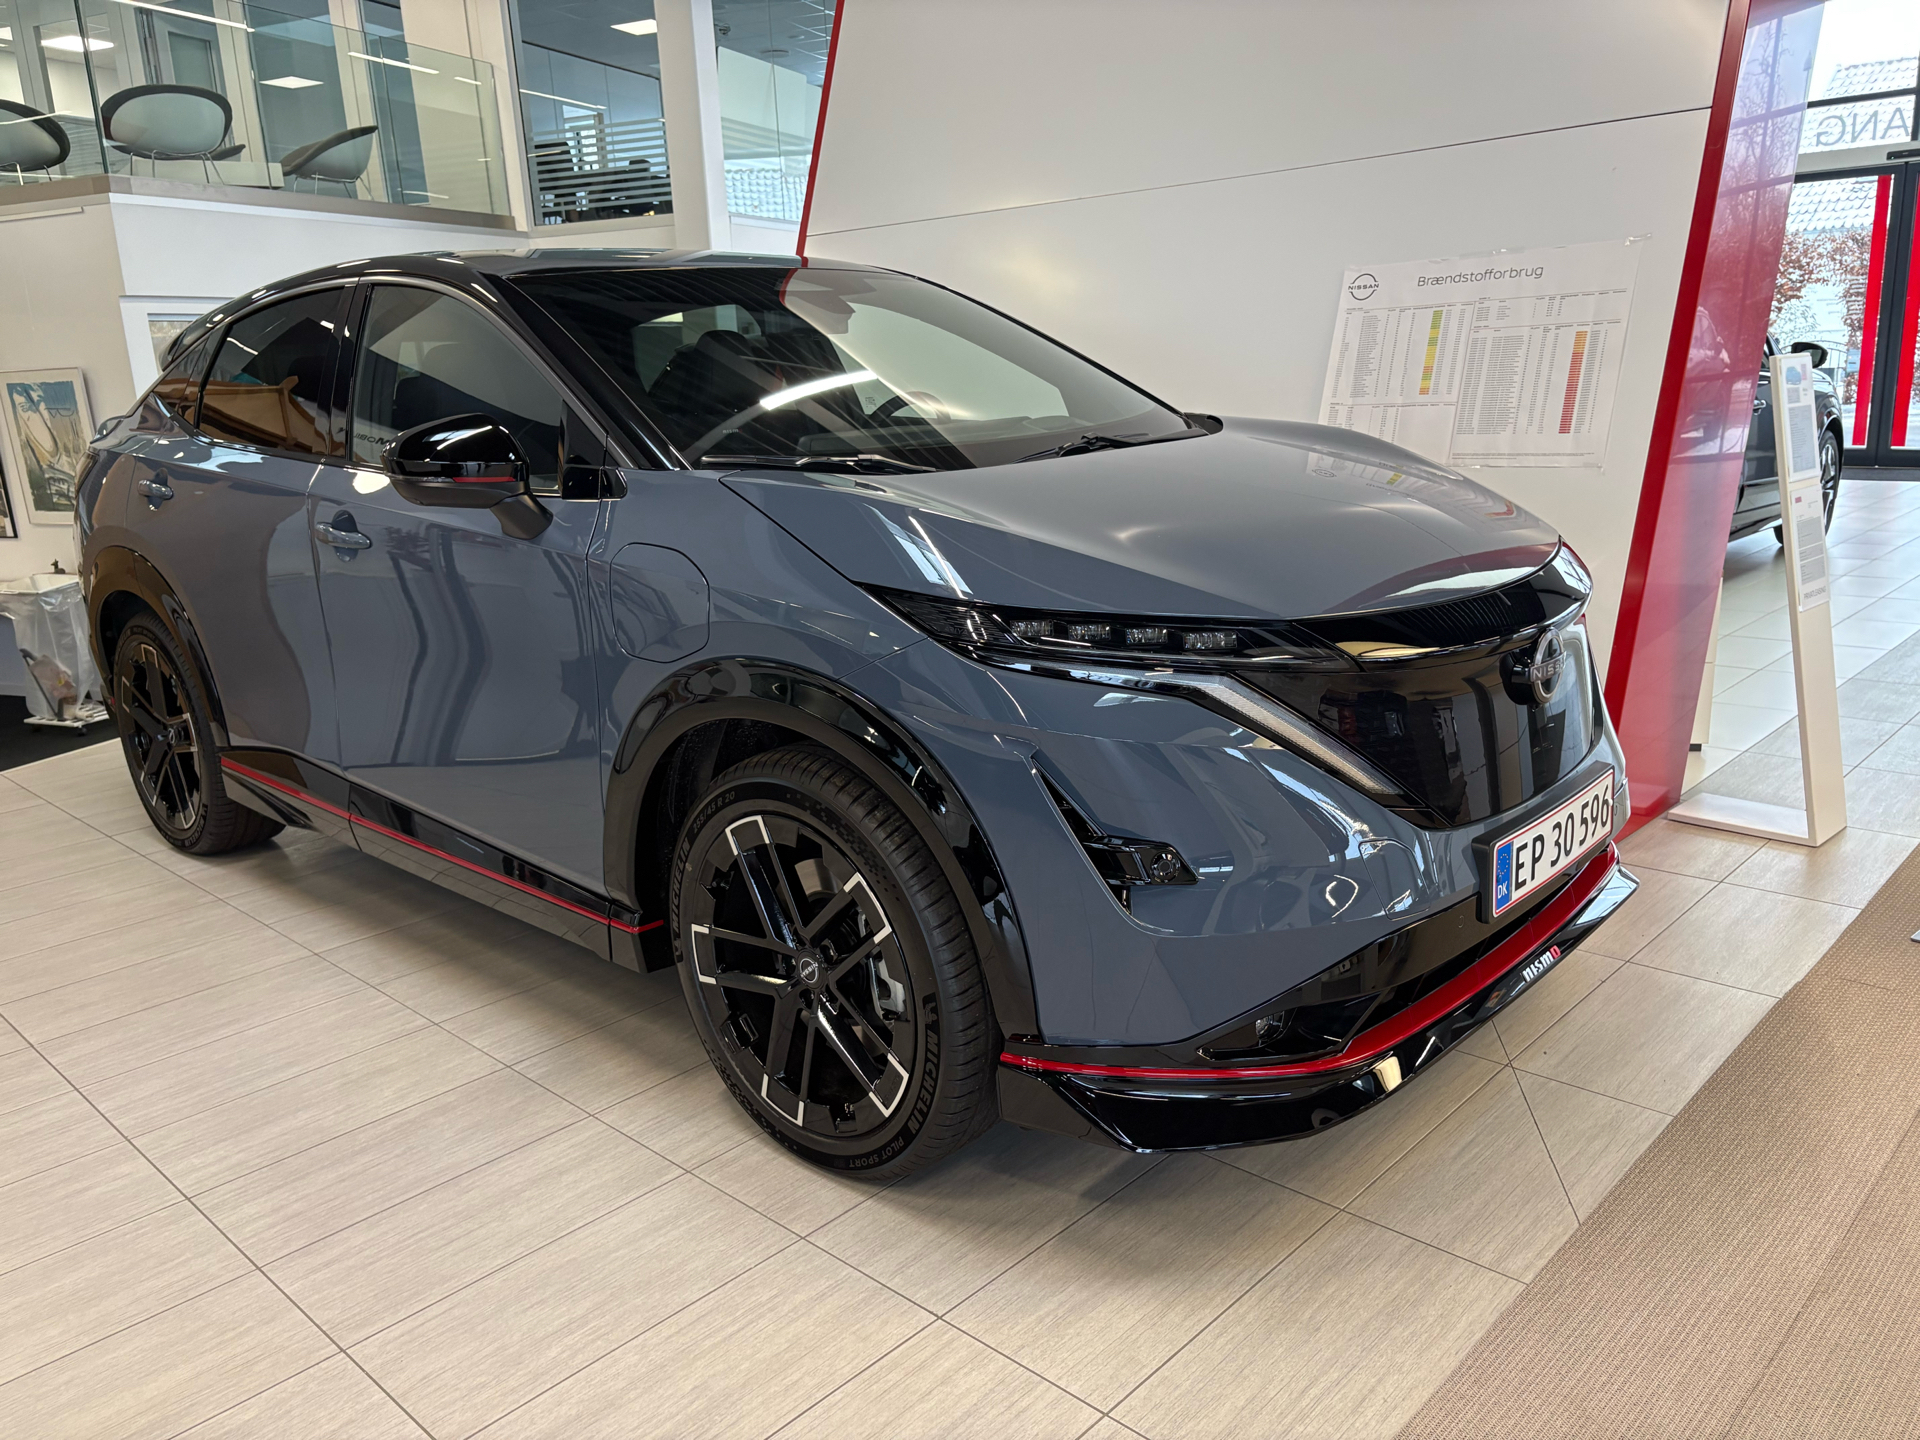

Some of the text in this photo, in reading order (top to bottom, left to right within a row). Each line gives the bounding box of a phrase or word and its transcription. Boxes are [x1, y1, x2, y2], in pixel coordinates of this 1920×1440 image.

[1348, 282, 1380, 291] NISSAN
[1417, 265, 1544, 287] Brændstofforbrug
[717, 796, 724, 807] R
[725, 790, 736, 803] 20
[1514, 784, 1610, 892] EP 30 596
[671, 837, 691, 935] MICHELIN
[1497, 880, 1508, 900] DK
[907, 1029, 939, 1135] MICHELIN
[882, 1136, 905, 1160] PILOT
[849, 1152, 879, 1168] SPORT
